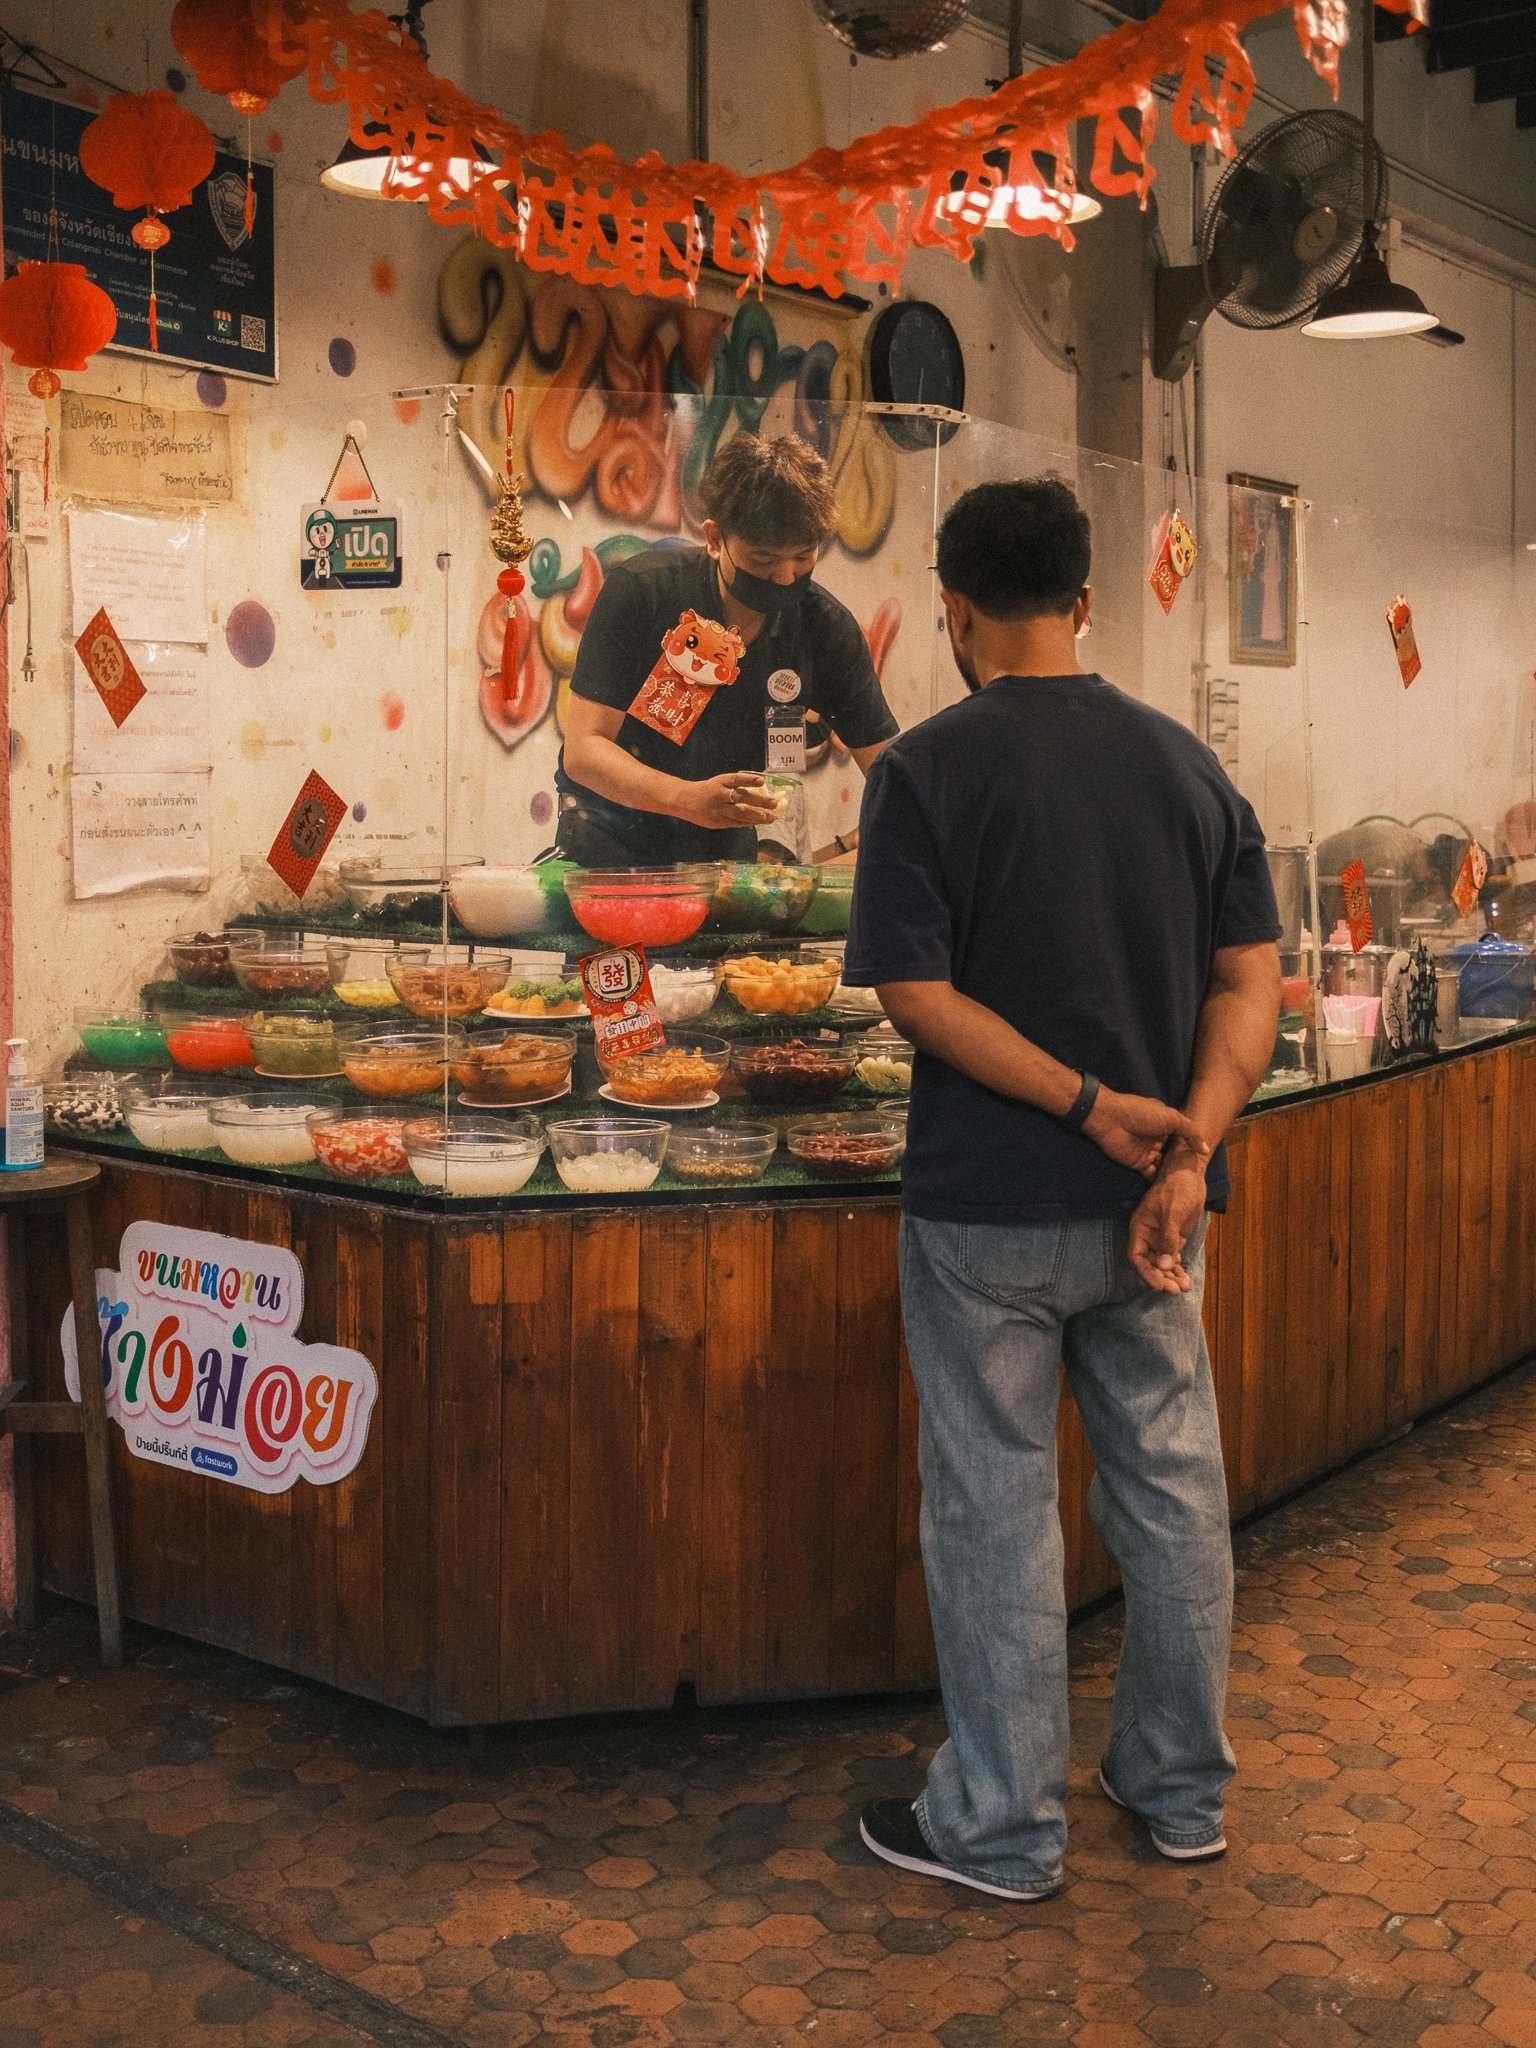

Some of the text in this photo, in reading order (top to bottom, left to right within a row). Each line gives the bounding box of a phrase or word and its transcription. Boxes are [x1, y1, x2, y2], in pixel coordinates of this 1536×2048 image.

[151, 260, 188, 277] ommerce
[344, 525, 389, 558] เปิด
[769, 734, 803, 744] BOOM
[137, 1248, 282, 1311] ขนมหวาน
[97, 1295, 354, 1464] ้างม่อย
[204, 1454, 234, 1471] fastwork
